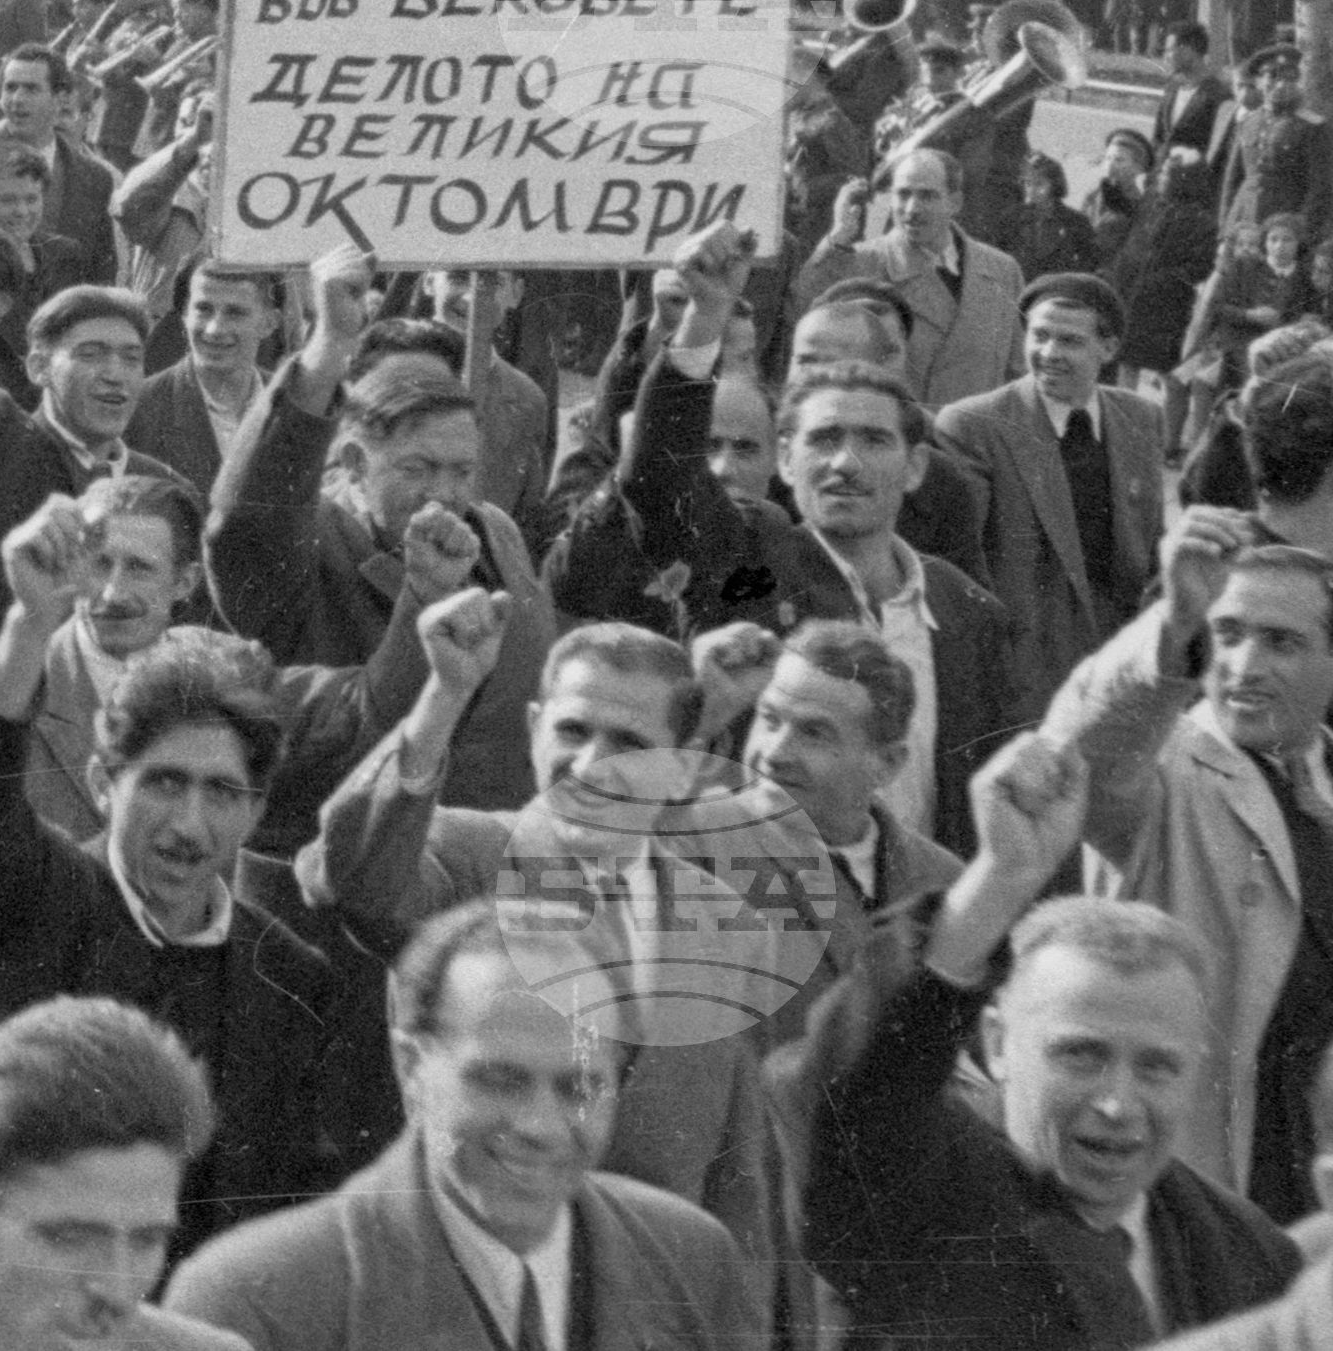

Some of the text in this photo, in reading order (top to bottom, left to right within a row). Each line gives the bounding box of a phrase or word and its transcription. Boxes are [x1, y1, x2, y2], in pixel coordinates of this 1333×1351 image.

[250, 52, 558, 111] ДЕЛОТО
[282, 112, 710, 166] ВЕЛИКИЯ
[236, 170, 748, 256] ОКТОМВРИ
